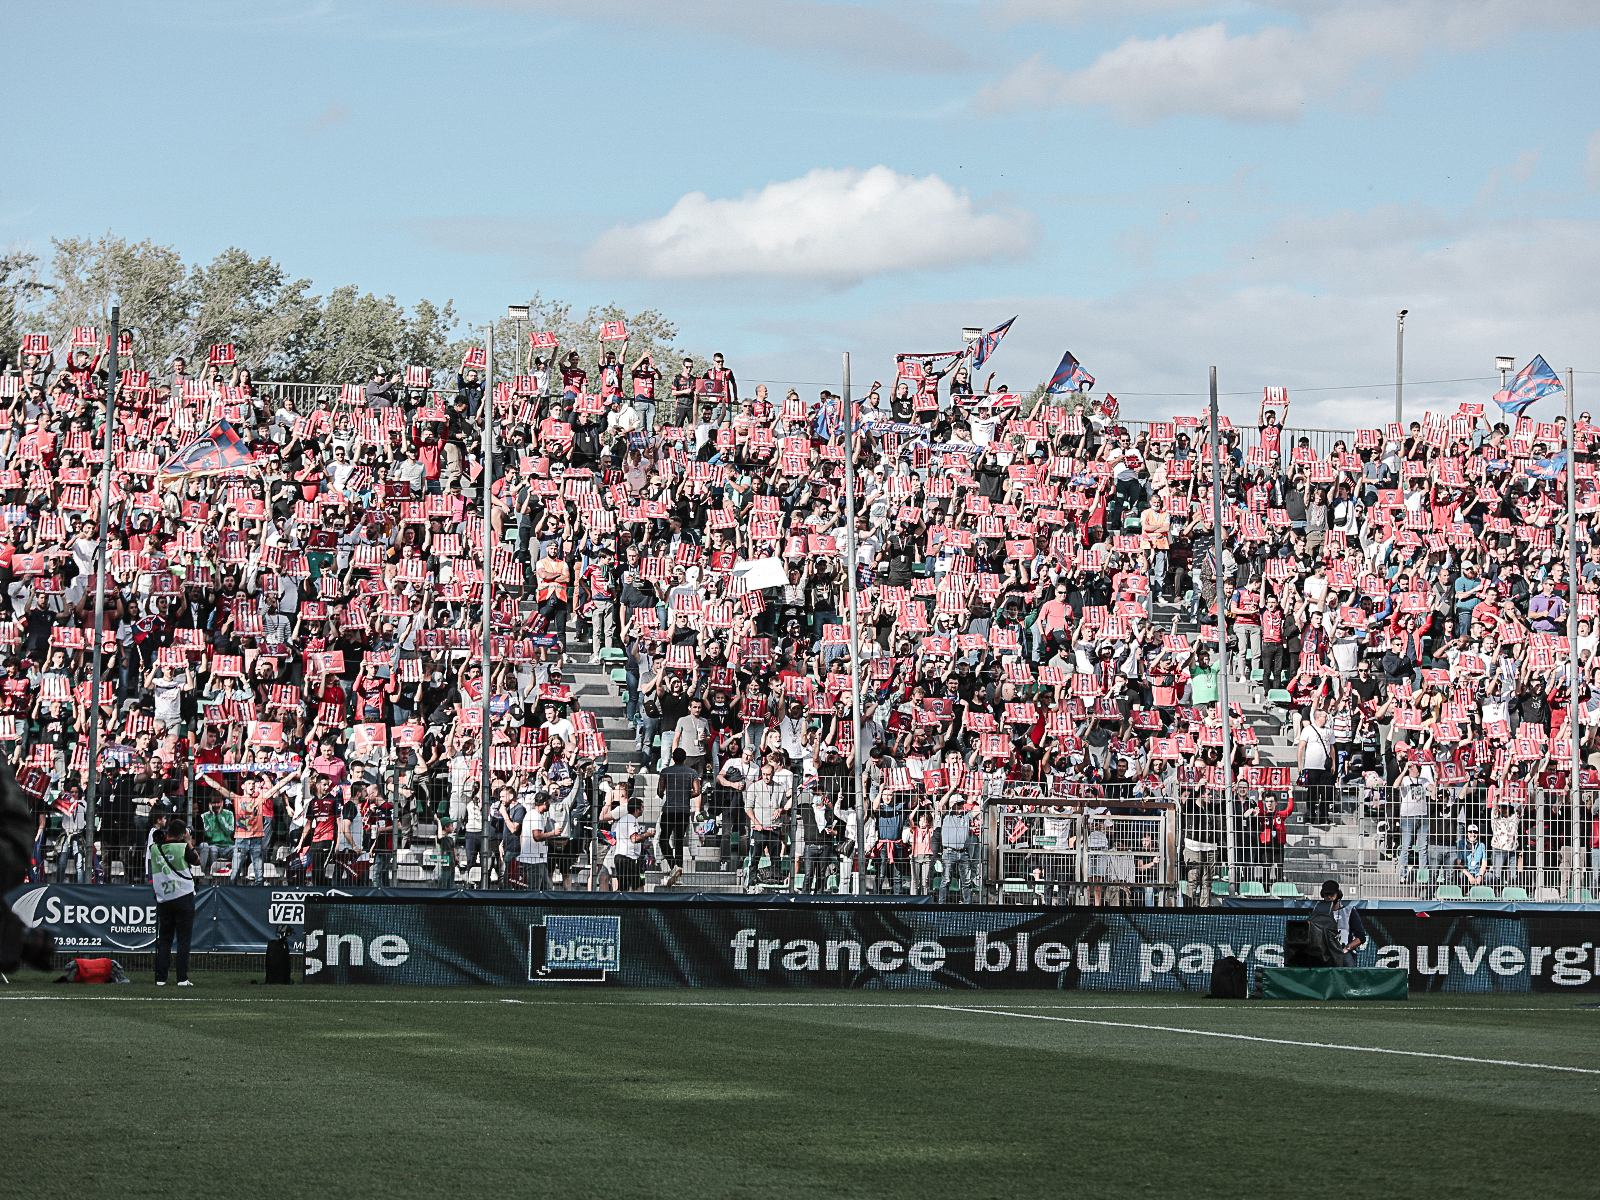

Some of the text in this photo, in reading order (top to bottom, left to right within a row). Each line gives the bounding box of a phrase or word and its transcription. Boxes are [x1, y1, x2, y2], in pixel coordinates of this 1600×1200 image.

[110, 925, 157, 934] FUNÉRAIRES
[548, 939, 615, 961] bleu
[730, 929, 946, 972] france
[974, 931, 1110, 973] bleu
[1140, 941, 1285, 983] pays
